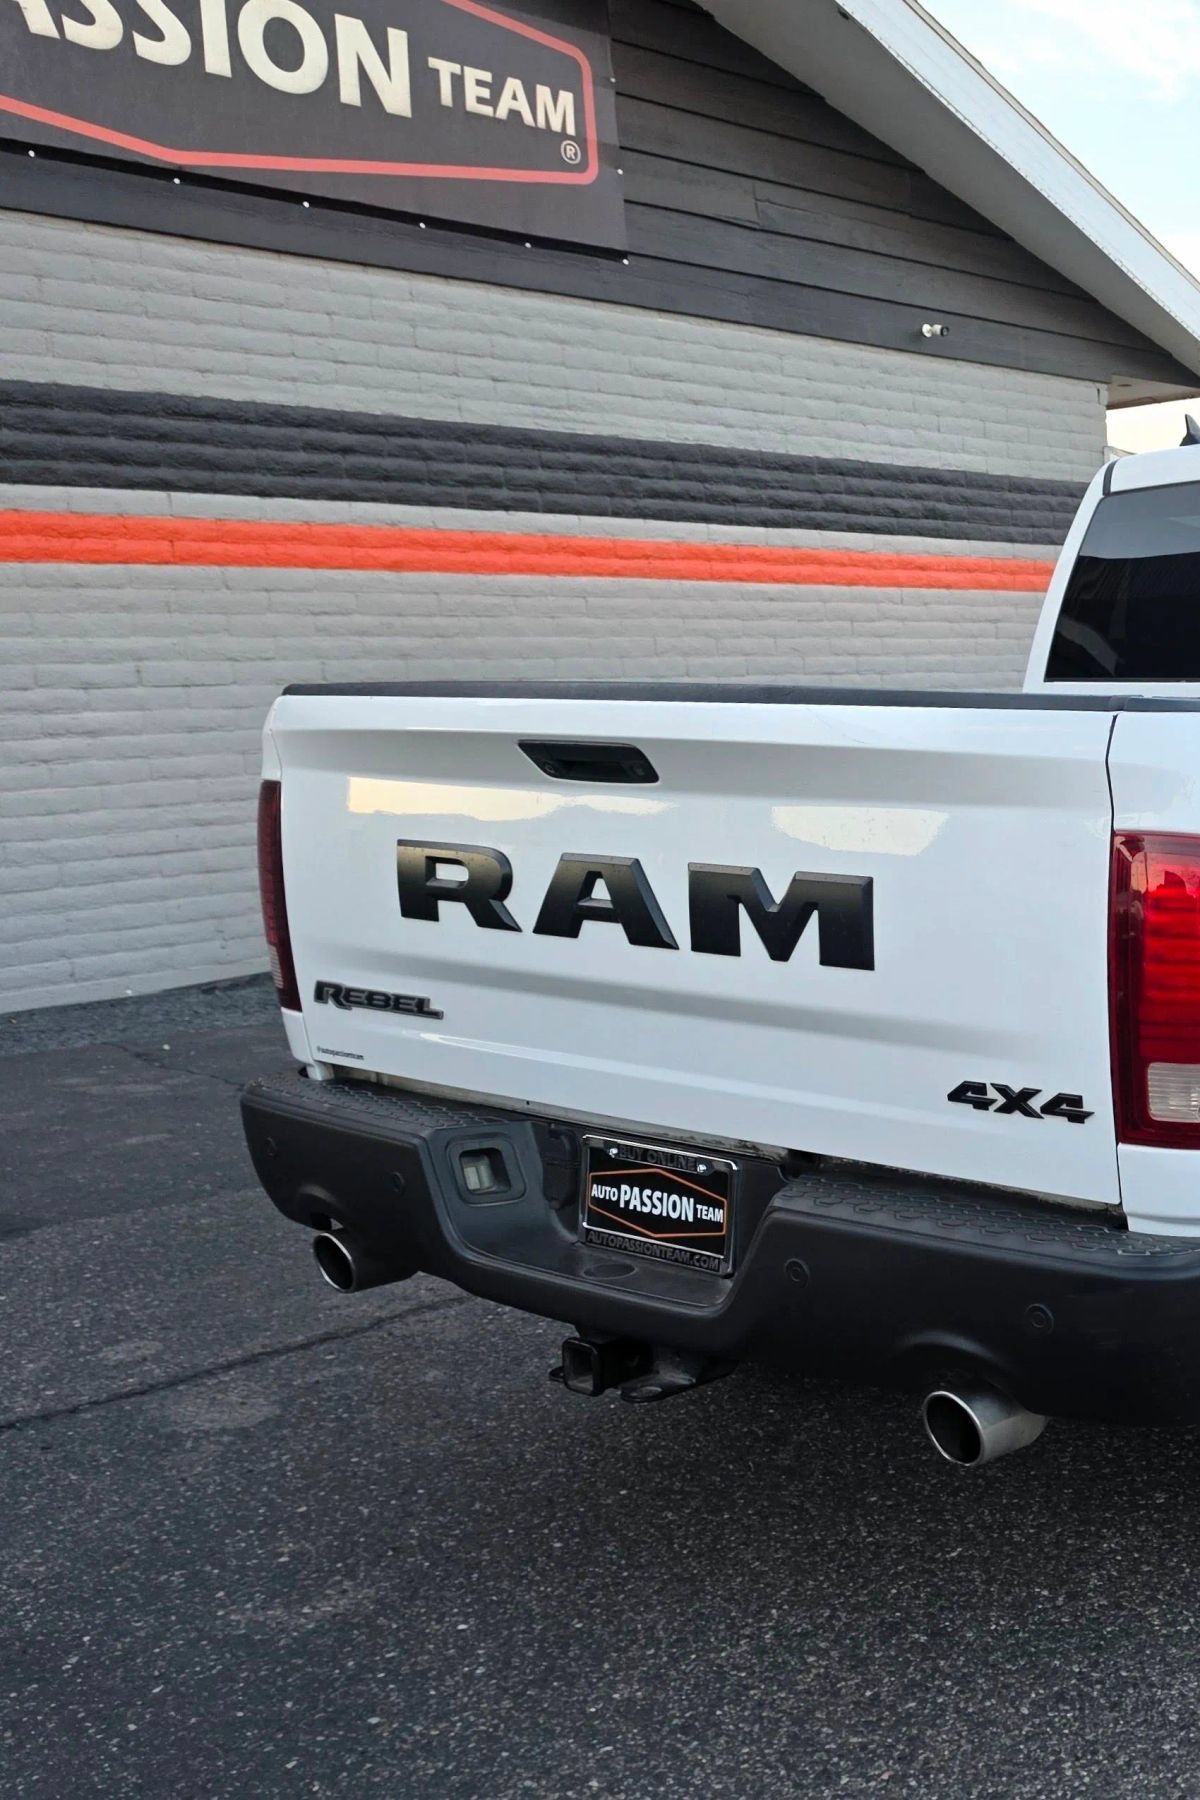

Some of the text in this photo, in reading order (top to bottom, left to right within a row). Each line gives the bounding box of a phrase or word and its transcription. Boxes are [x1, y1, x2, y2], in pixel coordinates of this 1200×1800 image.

[428, 56, 576, 136] TEAM
[397, 838, 875, 971] RAM
[314, 980, 444, 1020] REBEL
[619, 1145, 697, 1171] BUY ONLINE
[591, 1183, 724, 1223] AUTO PASSION TEAM
[587, 1230, 720, 1272] AUTOPASSIONTEAM.COM
